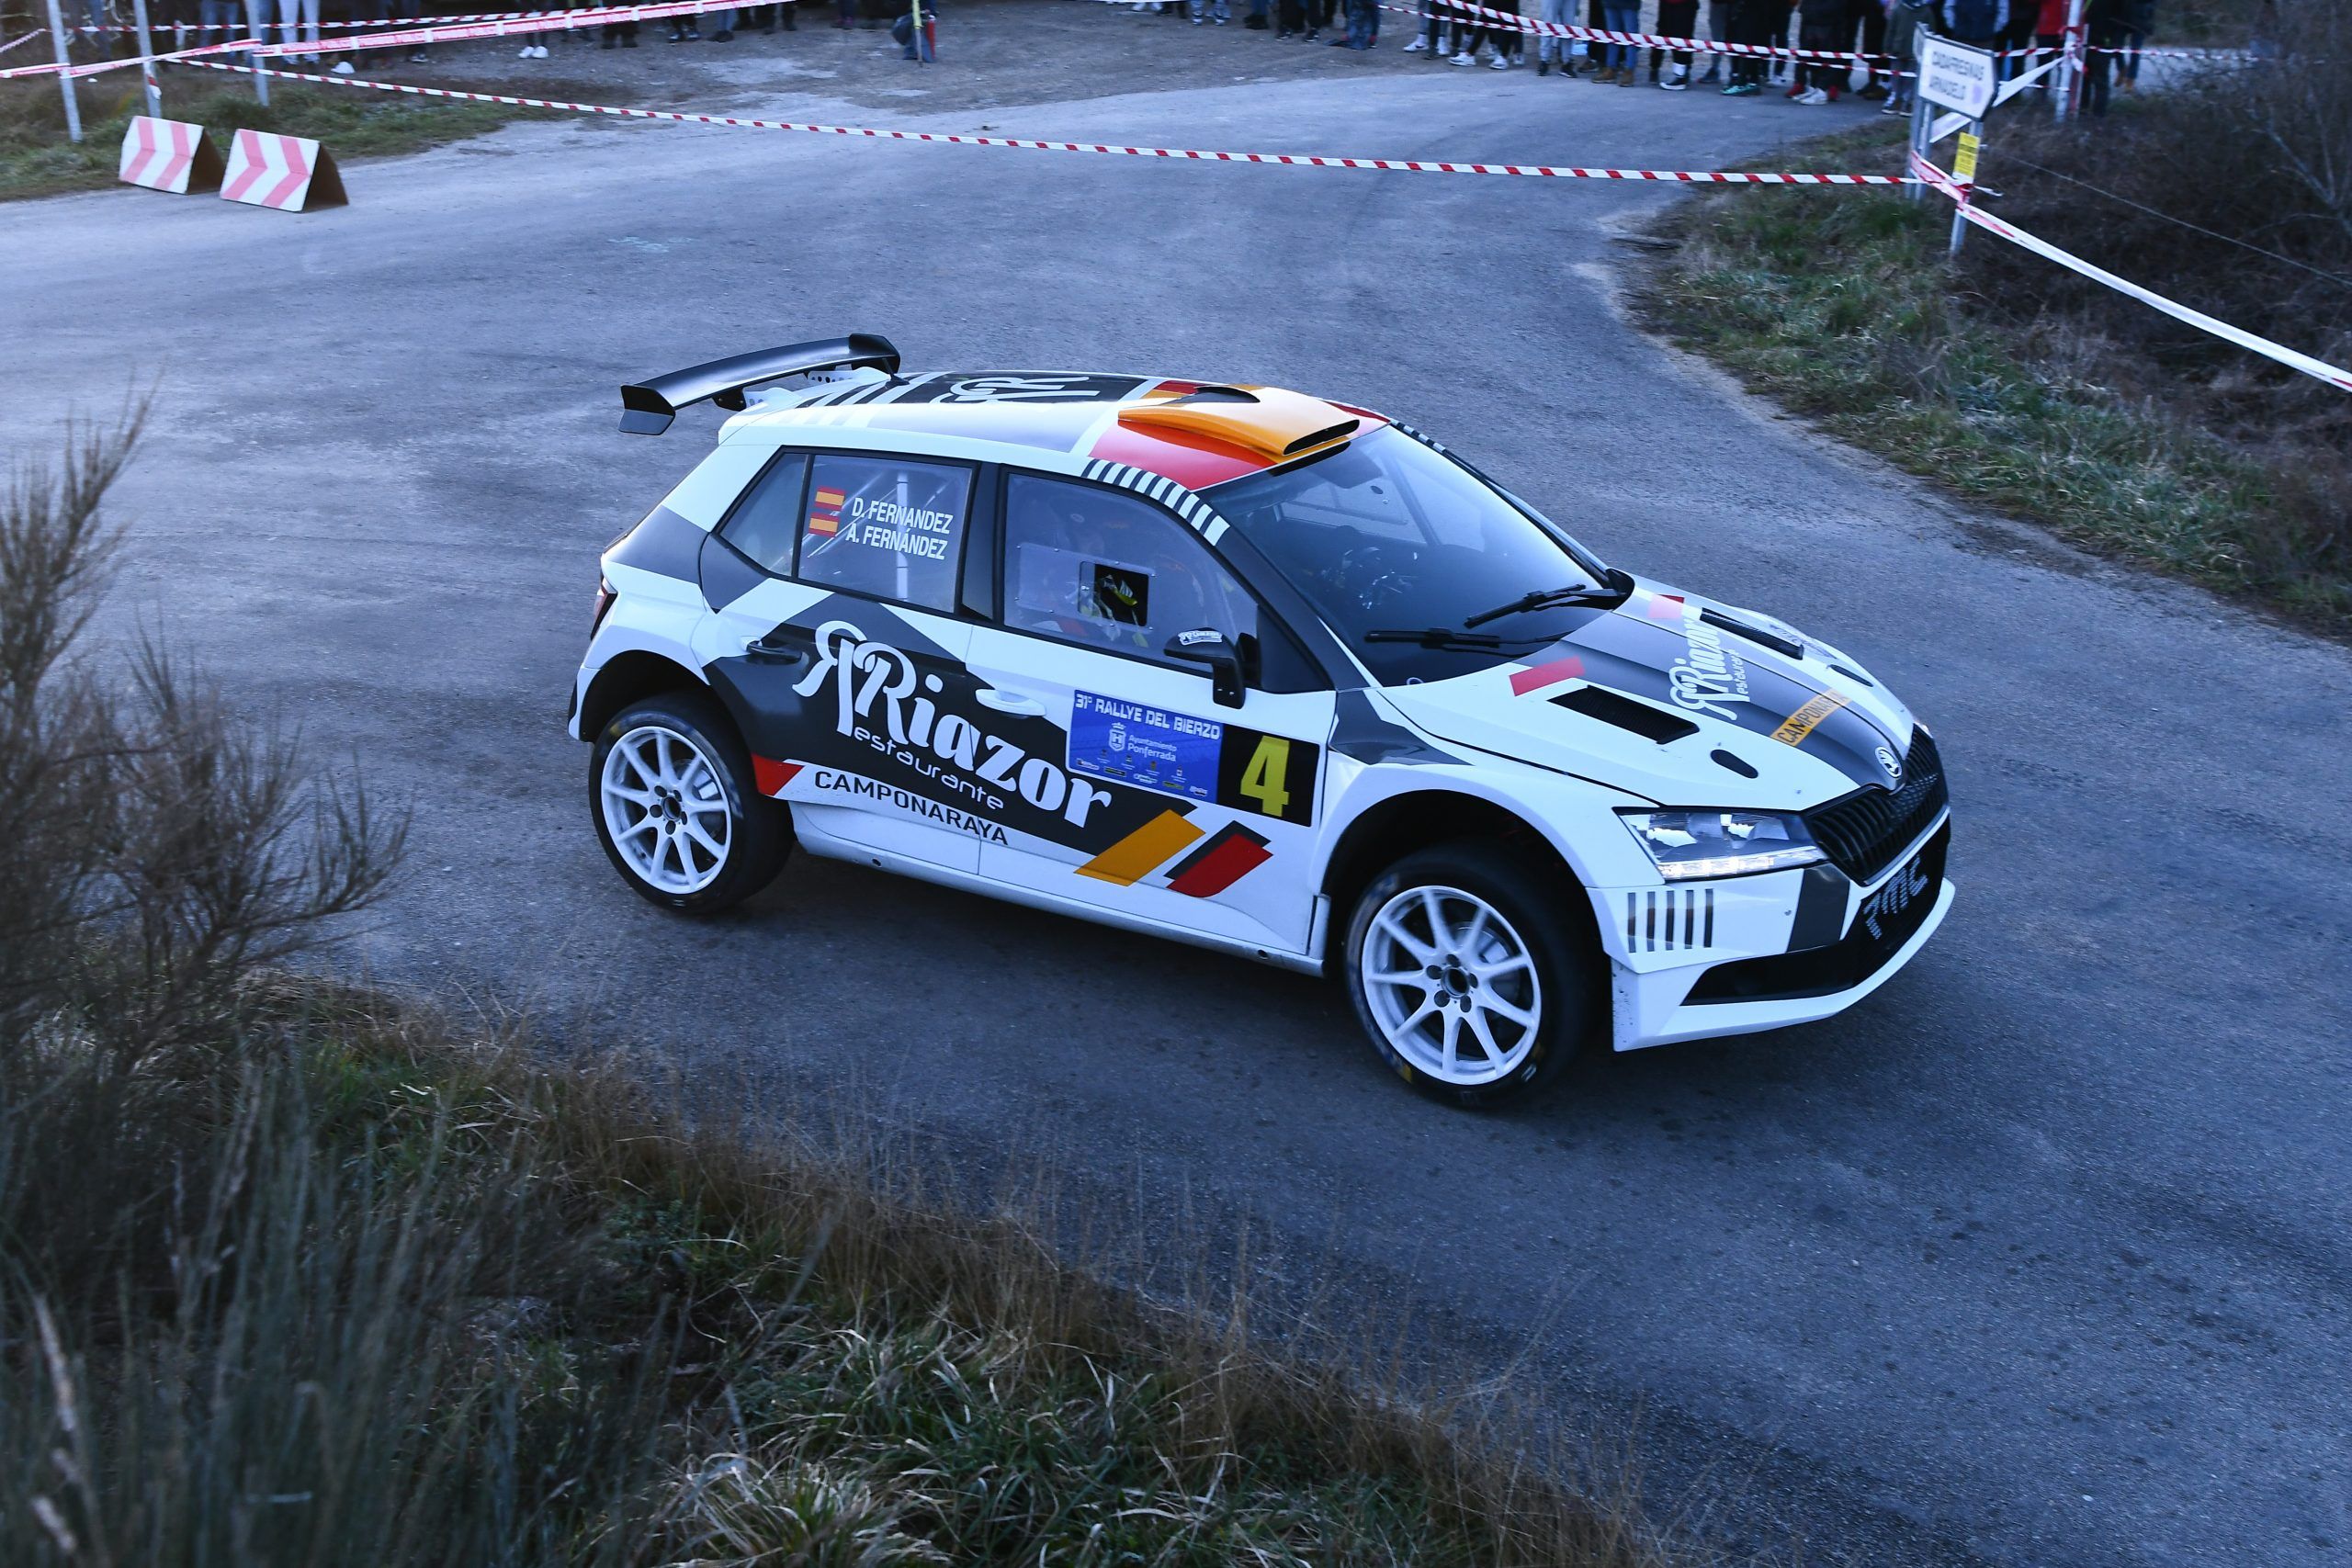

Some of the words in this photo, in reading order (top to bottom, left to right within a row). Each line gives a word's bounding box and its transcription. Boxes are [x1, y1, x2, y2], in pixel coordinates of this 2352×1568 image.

[852, 497, 865, 517] D.
[867, 500, 954, 535] FERNANDEZ
[845, 523, 859, 543] A.
[863, 525, 948, 560] FERNÁNDEZ
[1094, 698, 1144, 723] RALLYE
[1145, 709, 1170, 729] DEL
[1173, 716, 1221, 740] BIERZO
[1127, 741, 1177, 762] Ponferrada
[1128, 734, 1178, 752] Ayuntamiento
[854, 725, 1004, 811] estaurante
[1239, 734, 1291, 818] 4
[814, 770, 1009, 846] CAMPONARAYA
